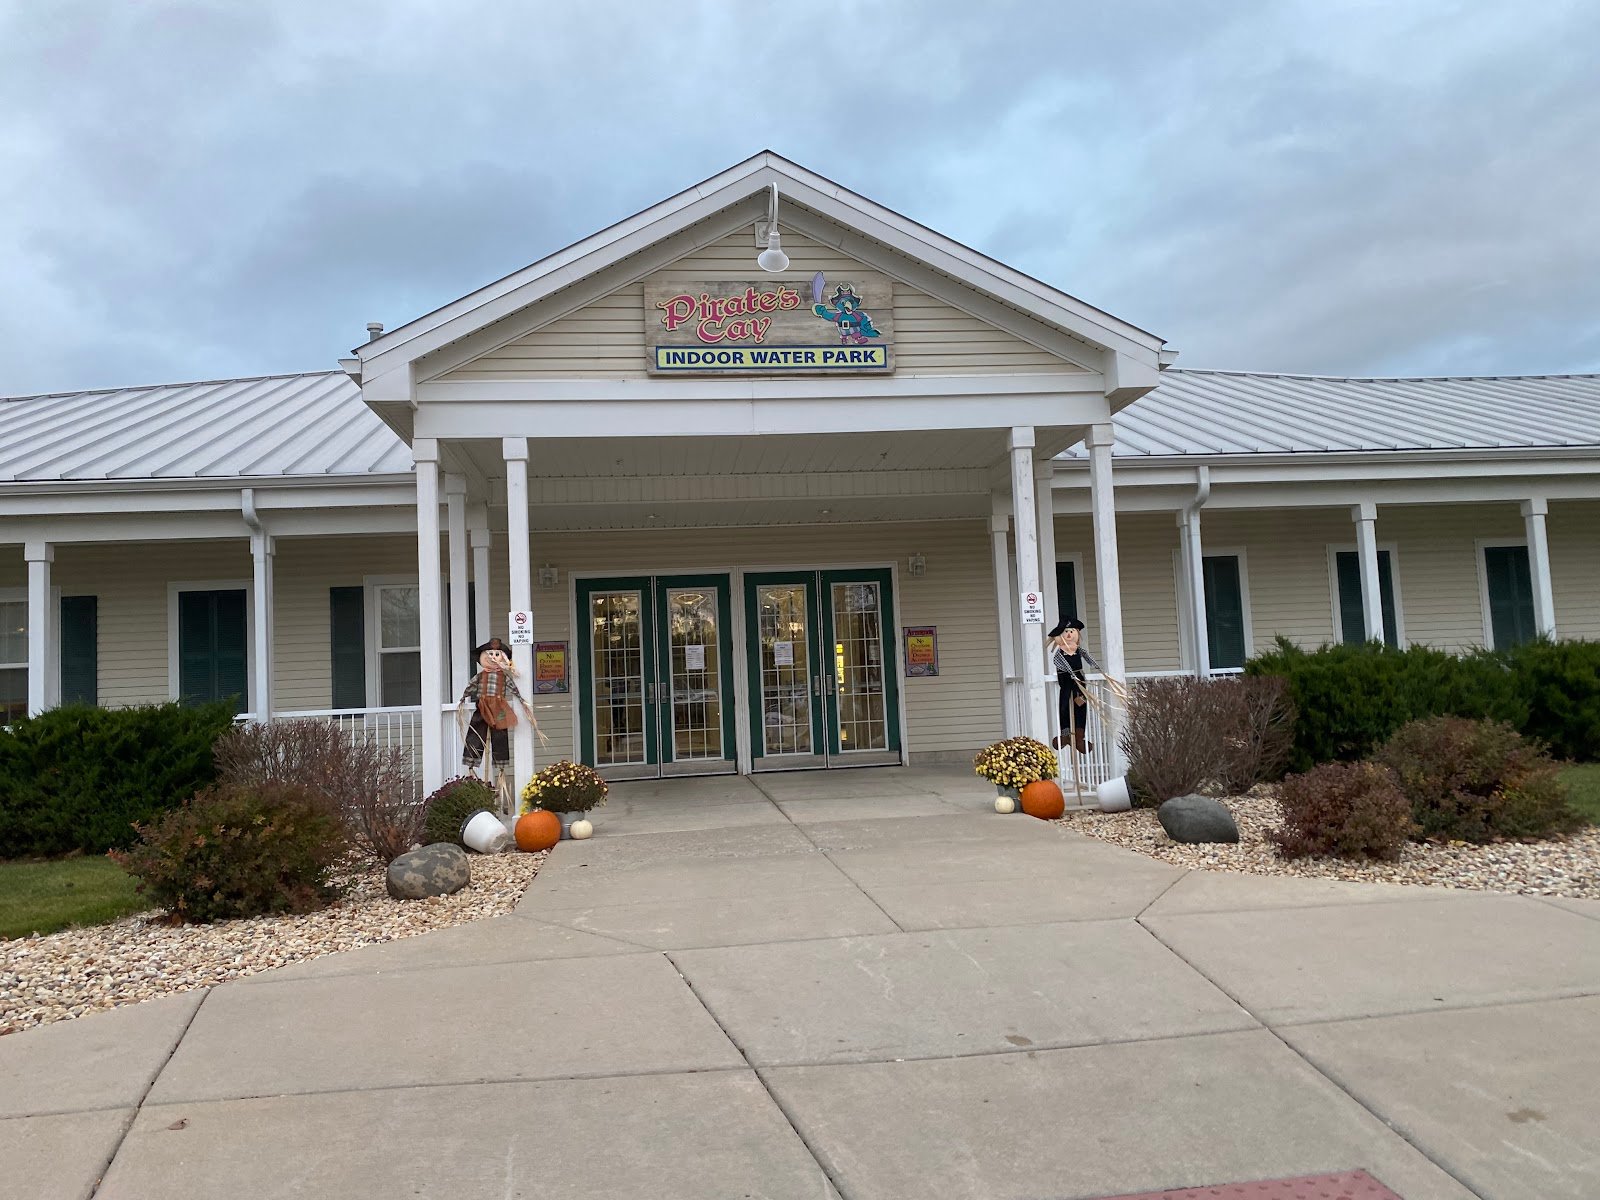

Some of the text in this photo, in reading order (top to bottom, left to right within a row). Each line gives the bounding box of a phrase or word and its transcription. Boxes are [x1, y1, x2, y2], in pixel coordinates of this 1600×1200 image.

[656, 285, 801, 331] Pirate's
[696, 316, 772, 344] Cay
[665, 350, 877, 365] INDOOR WATER PARK
